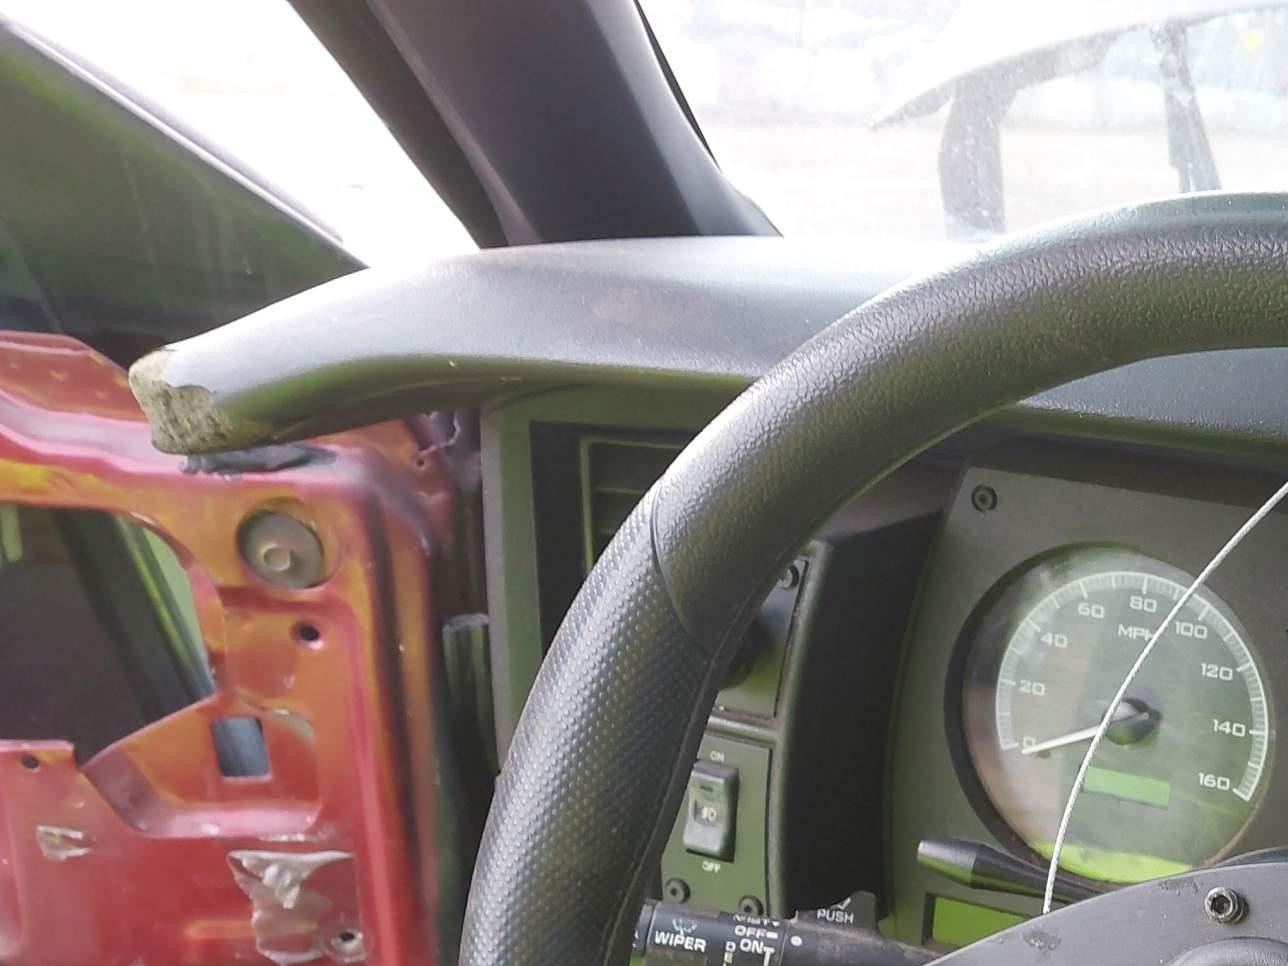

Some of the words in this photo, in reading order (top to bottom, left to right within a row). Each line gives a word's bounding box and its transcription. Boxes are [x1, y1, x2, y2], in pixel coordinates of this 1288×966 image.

[1078, 602, 1105, 618] 60
[1130, 596, 1157, 613] 80
[1175, 621, 1208, 639] 100
[1041, 632, 1068, 648] 40
[1201, 663, 1233, 681] 120
[1020, 680, 1046, 696] 20
[1213, 719, 1246, 737] 140
[710, 750, 725, 762] ON
[1199, 773, 1230, 790] 160
[817, 908, 854, 924] PUSH
[735, 925, 767, 938] OFF
[655, 930, 707, 952] WIPER
[740, 938, 765, 954] ON
